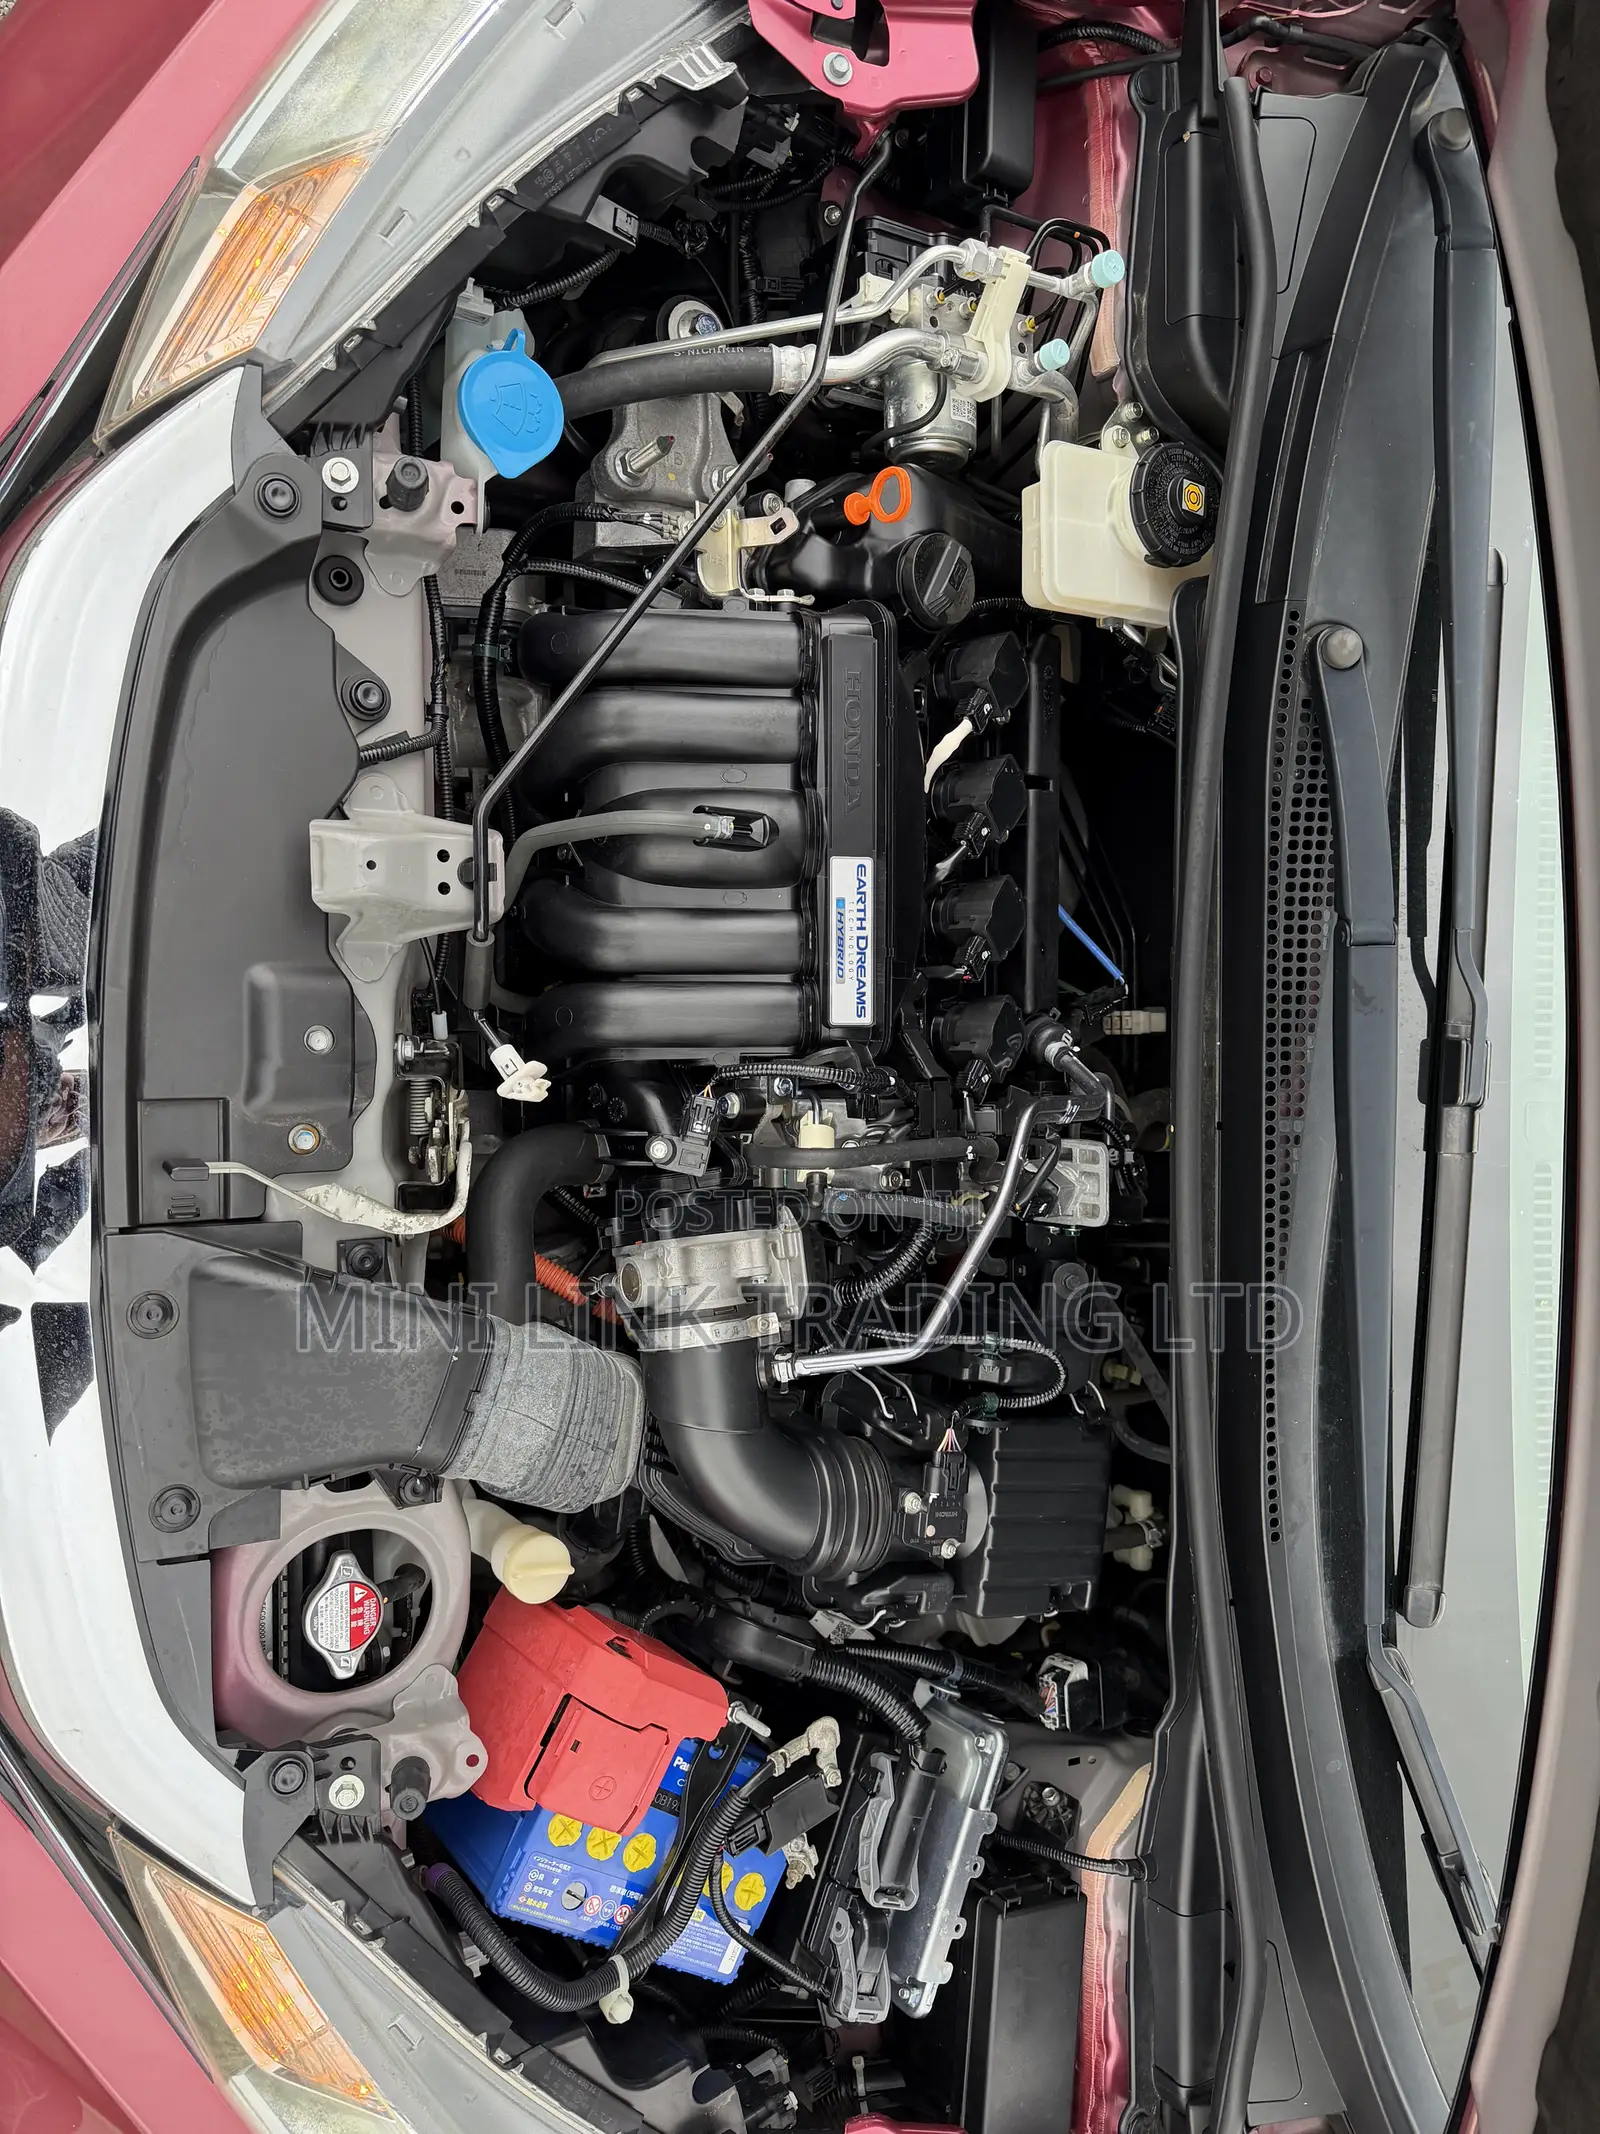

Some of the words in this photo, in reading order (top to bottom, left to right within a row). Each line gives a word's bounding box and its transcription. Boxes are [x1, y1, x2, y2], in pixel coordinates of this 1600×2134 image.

[844, 667, 862, 817] HONDA
[856, 863, 867, 931] EARTH
[836, 911, 845, 979] HYBRID
[856, 934, 869, 1019] DREAMS
[369, 1597, 377, 1627] DANGER
